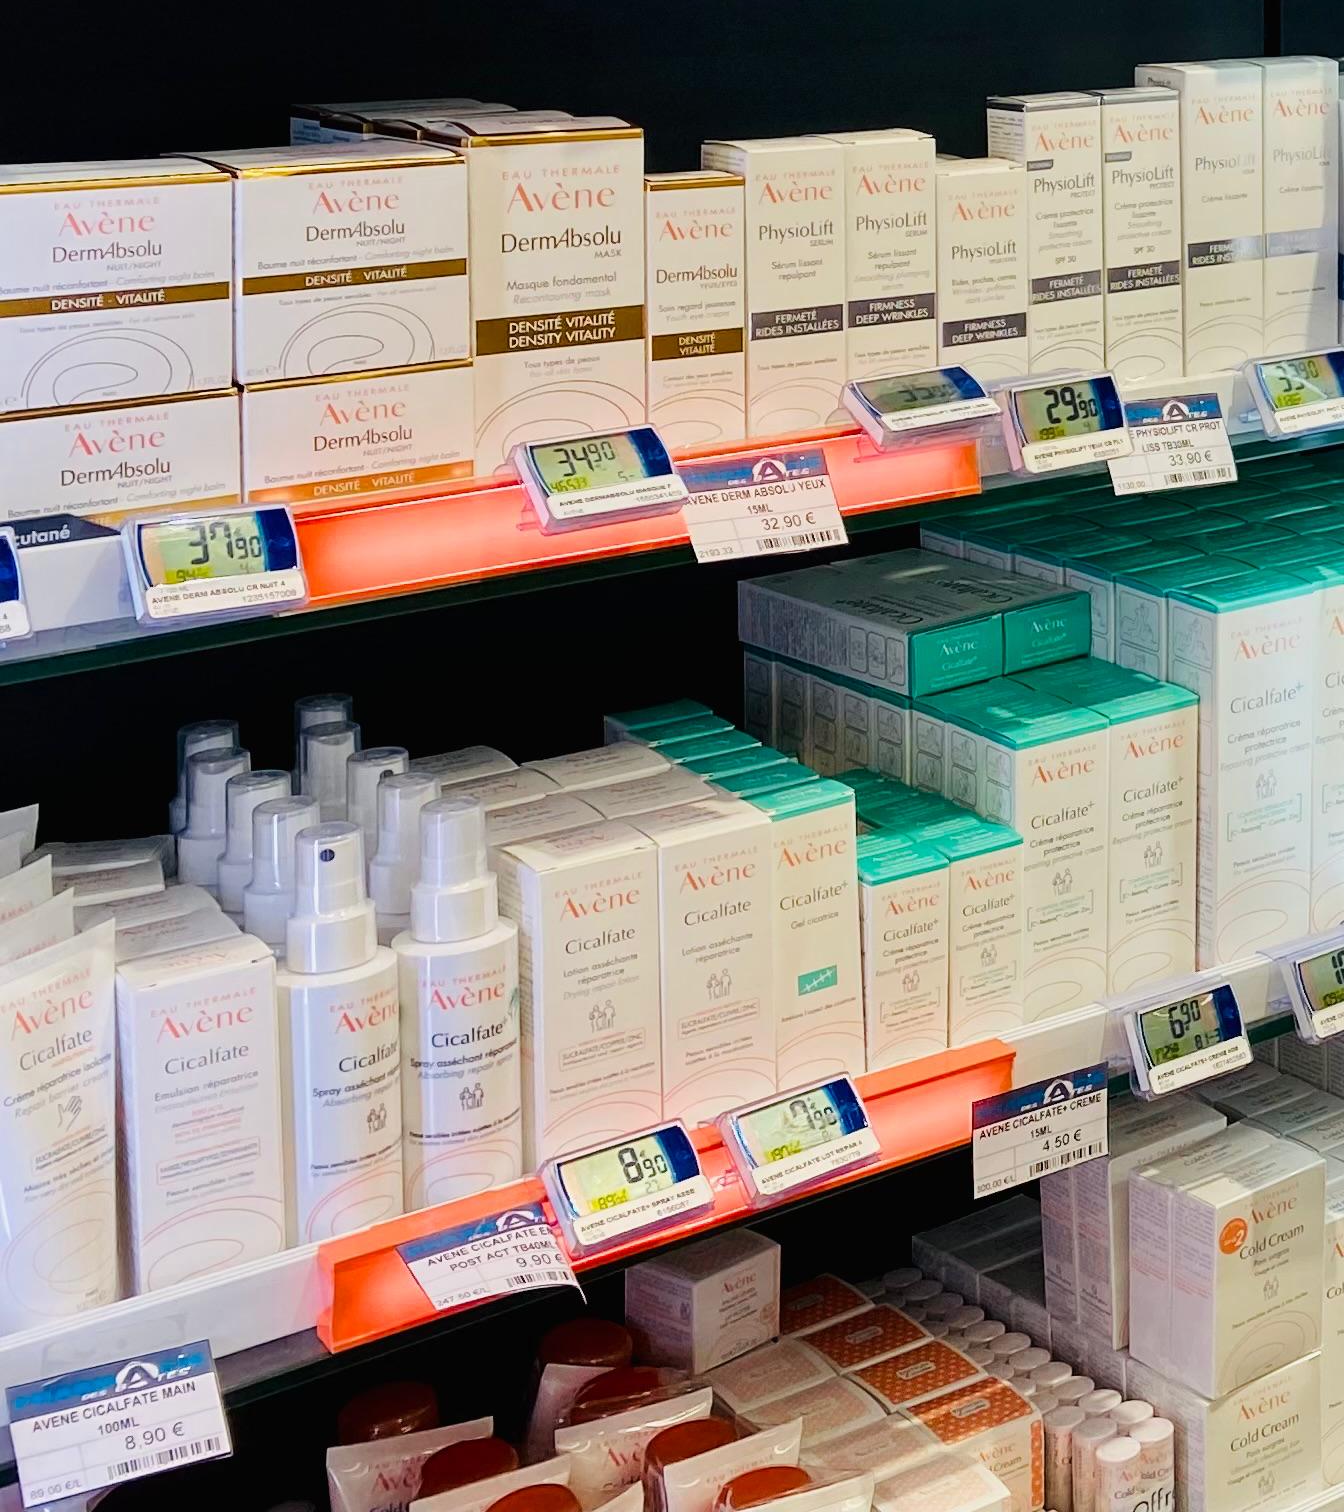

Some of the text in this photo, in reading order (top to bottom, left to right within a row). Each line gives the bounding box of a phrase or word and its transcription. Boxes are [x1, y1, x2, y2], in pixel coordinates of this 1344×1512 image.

[502, 165, 621, 181] EAU THERMALE
[313, 189, 400, 216] Avène
[508, 183, 615, 214] Avène
[305, 218, 405, 243] DermAbsolu
[759, 221, 834, 242] PhysioLift
[856, 211, 928, 233] PhysioLift
[501, 226, 622, 254] DermAbsolu
[594, 249, 622, 259] MASK
[305, 265, 407, 287] DENSITÉ VITALITÉ
[508, 311, 616, 334] DENSITÉ VITALITÉ
[508, 326, 616, 349] DENSITY VITALITY
[685, 493, 719, 509] AVENE
[721, 491, 750, 503] DERM
[798, 478, 826, 492] YEUX
[748, 503, 774, 515] 15ML
[805, 512, 816, 526] €
[680, 860, 756, 894] Avène
[684, 898, 752, 929] Cicalfate
[565, 925, 636, 956] Cicalfate
[156, 1001, 254, 1045] Avène
[164, 1040, 250, 1078] Cicalfate
[980, 1093, 1101, 1140] AVENE CICALFATE+ CREME
[1030, 1126, 1052, 1138] 15ML
[1073, 1129, 1081, 1141] €
[32, 1380, 196, 1435] AVENE CICALFATE MAIN
[97, 1414, 140, 1438] 100ML
[171, 1421, 185, 1439] €
